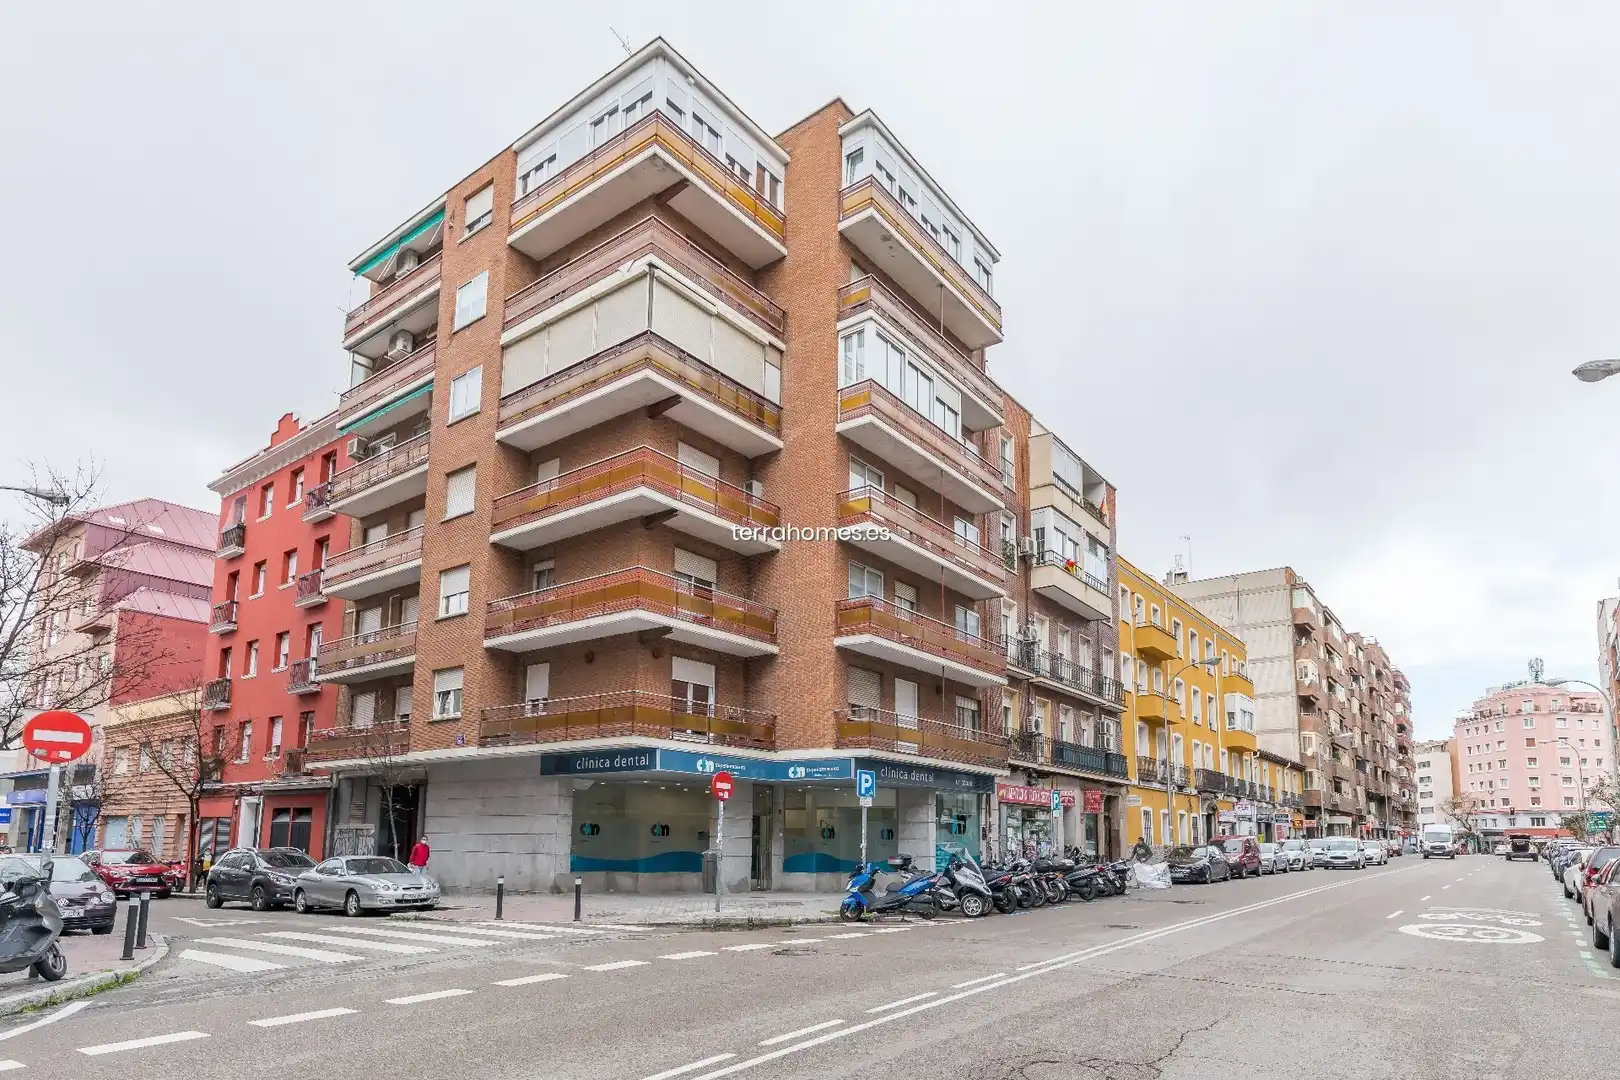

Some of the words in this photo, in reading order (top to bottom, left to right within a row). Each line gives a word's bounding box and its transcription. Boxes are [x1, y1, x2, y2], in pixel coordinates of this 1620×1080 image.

[614, 753, 649, 767] dental
[910, 770, 934, 782] dental
[861, 773, 872, 794] P
[1053, 793, 1059, 808] P
